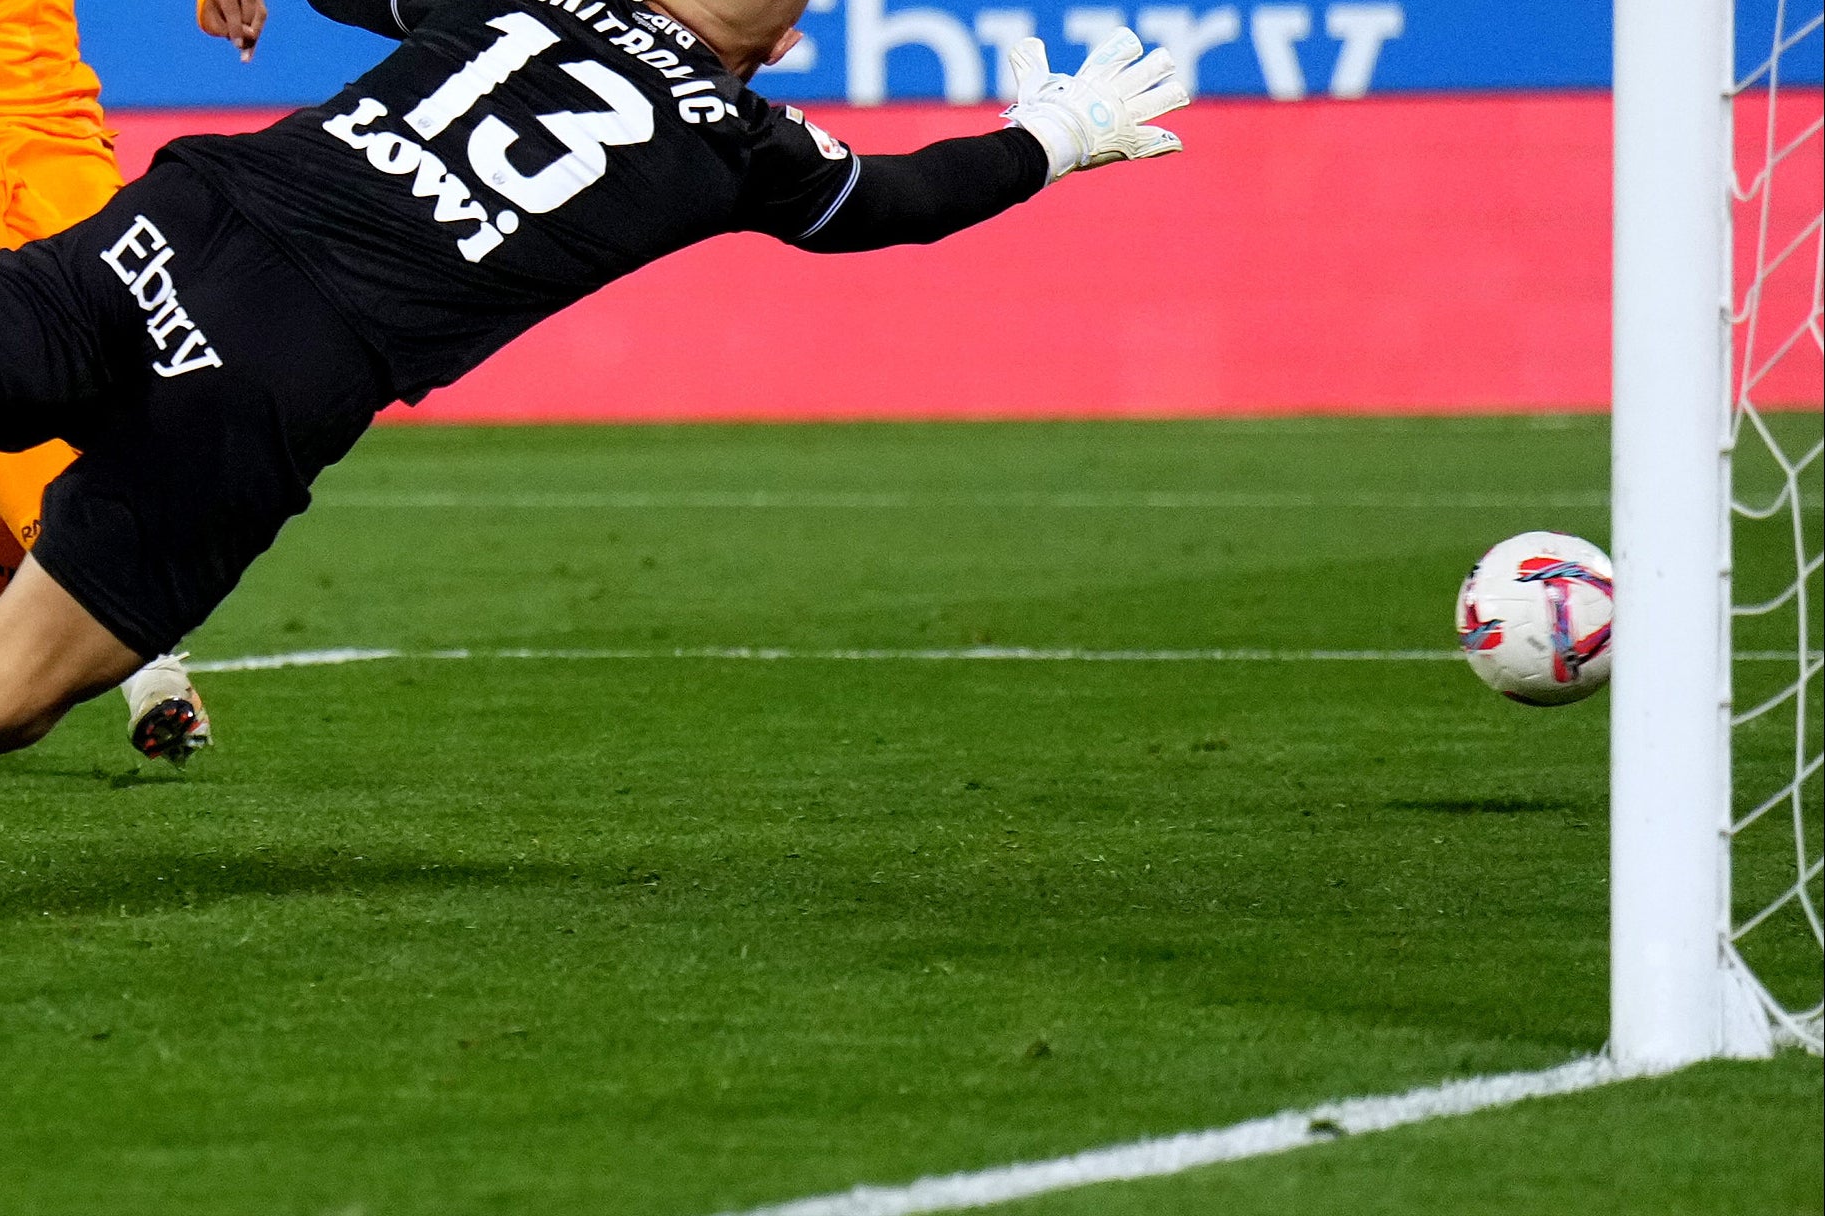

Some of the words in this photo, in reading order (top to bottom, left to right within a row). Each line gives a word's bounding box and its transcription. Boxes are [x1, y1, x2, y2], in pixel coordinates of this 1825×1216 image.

[322, 98, 519, 262] Lowi
[403, 11, 654, 214] 13
[99, 214, 223, 377] Ebury
